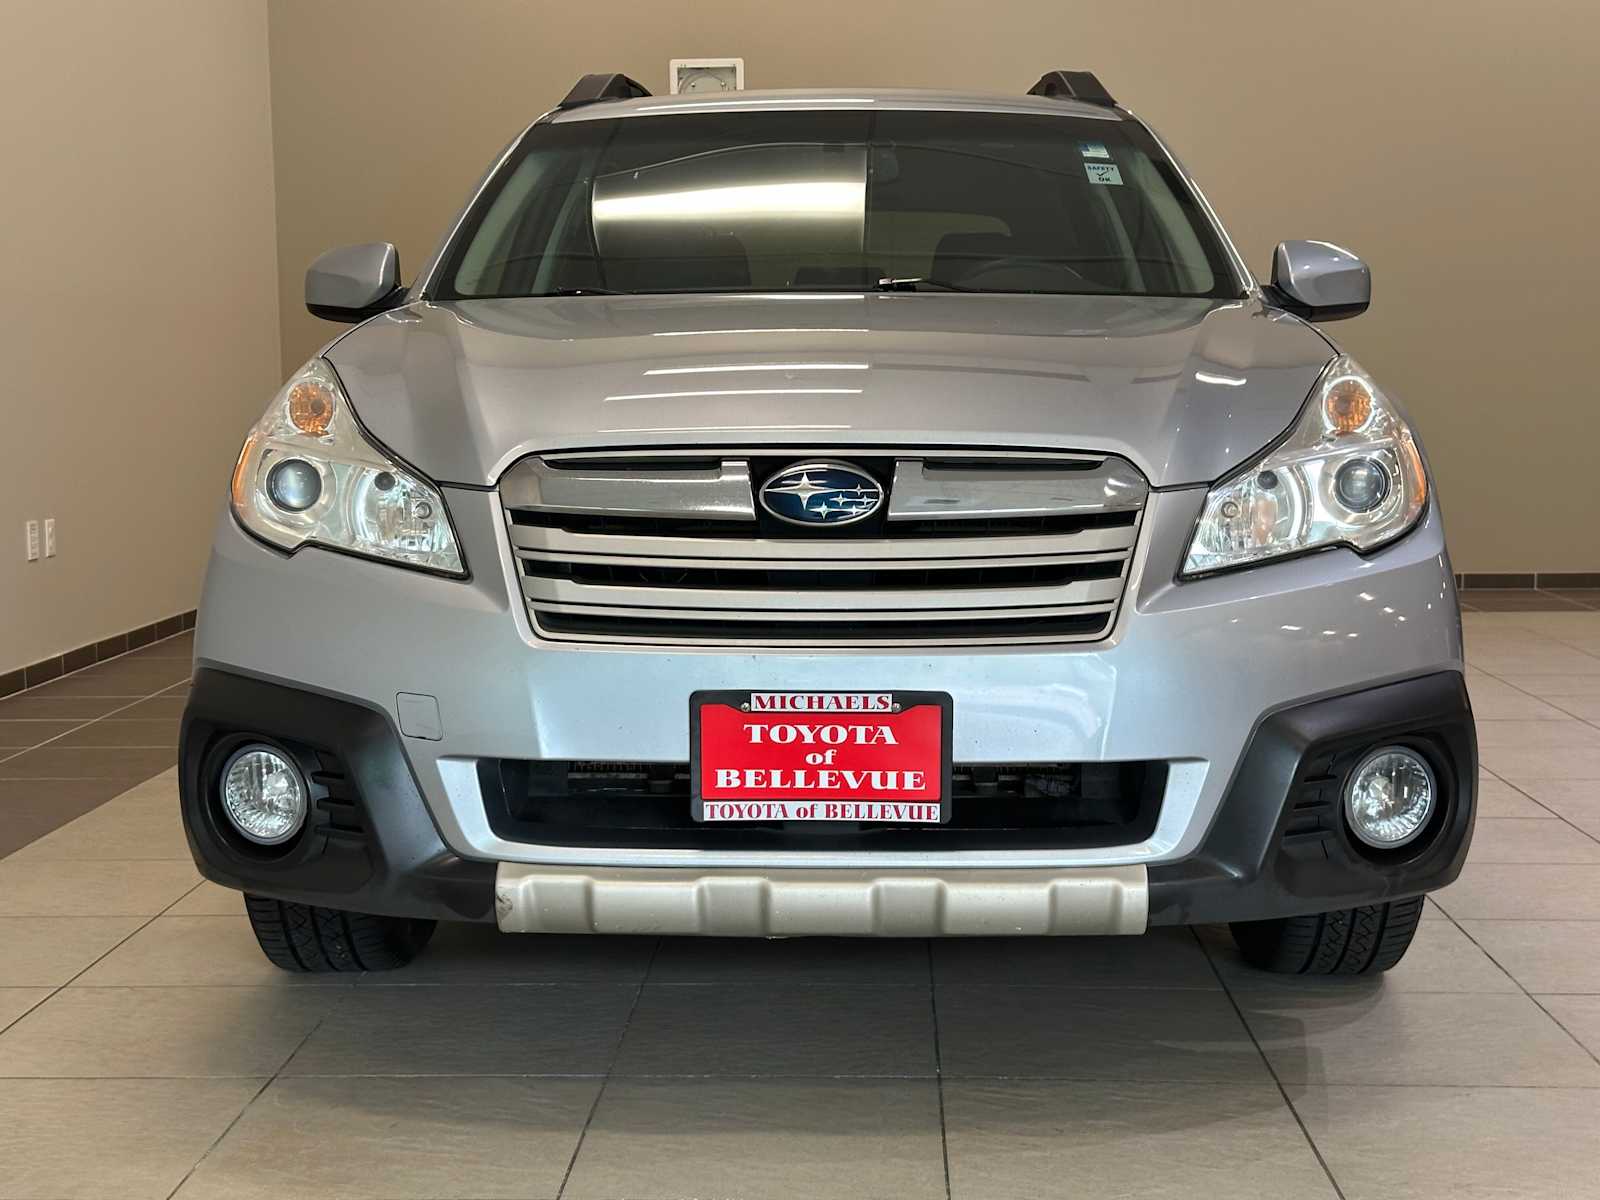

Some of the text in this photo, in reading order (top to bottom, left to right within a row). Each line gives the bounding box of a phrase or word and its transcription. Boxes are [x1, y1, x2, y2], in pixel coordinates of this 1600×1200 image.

[755, 695, 889, 710] MICHAELS
[743, 724, 899, 745] TOYOTA
[805, 749, 837, 765] of
[714, 769, 926, 790] BELLEVUE
[705, 803, 938, 820] TOYOTA of BELLEVUE
